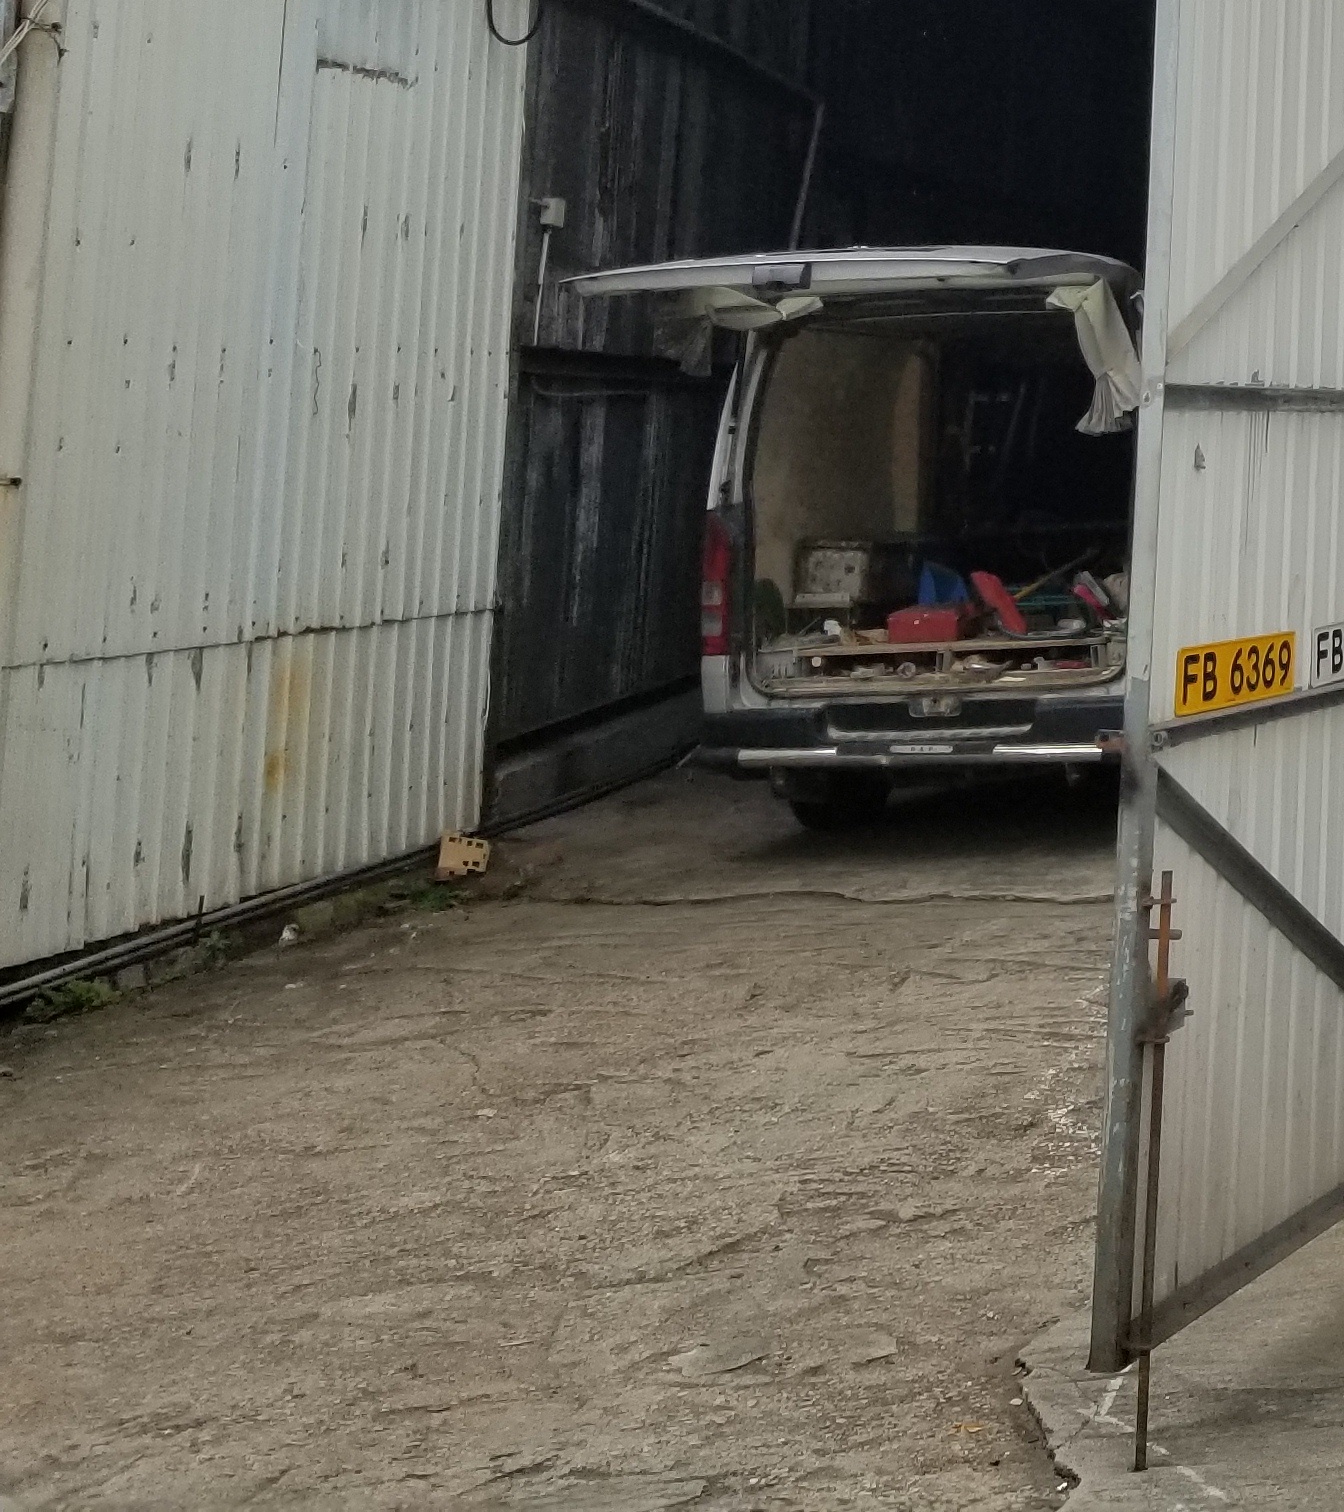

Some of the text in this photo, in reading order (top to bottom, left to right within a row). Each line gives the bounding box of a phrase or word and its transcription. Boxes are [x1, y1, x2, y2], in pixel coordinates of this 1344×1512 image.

[1183, 640, 1292, 705] FB 6369
[1316, 628, 1343, 679] FB
